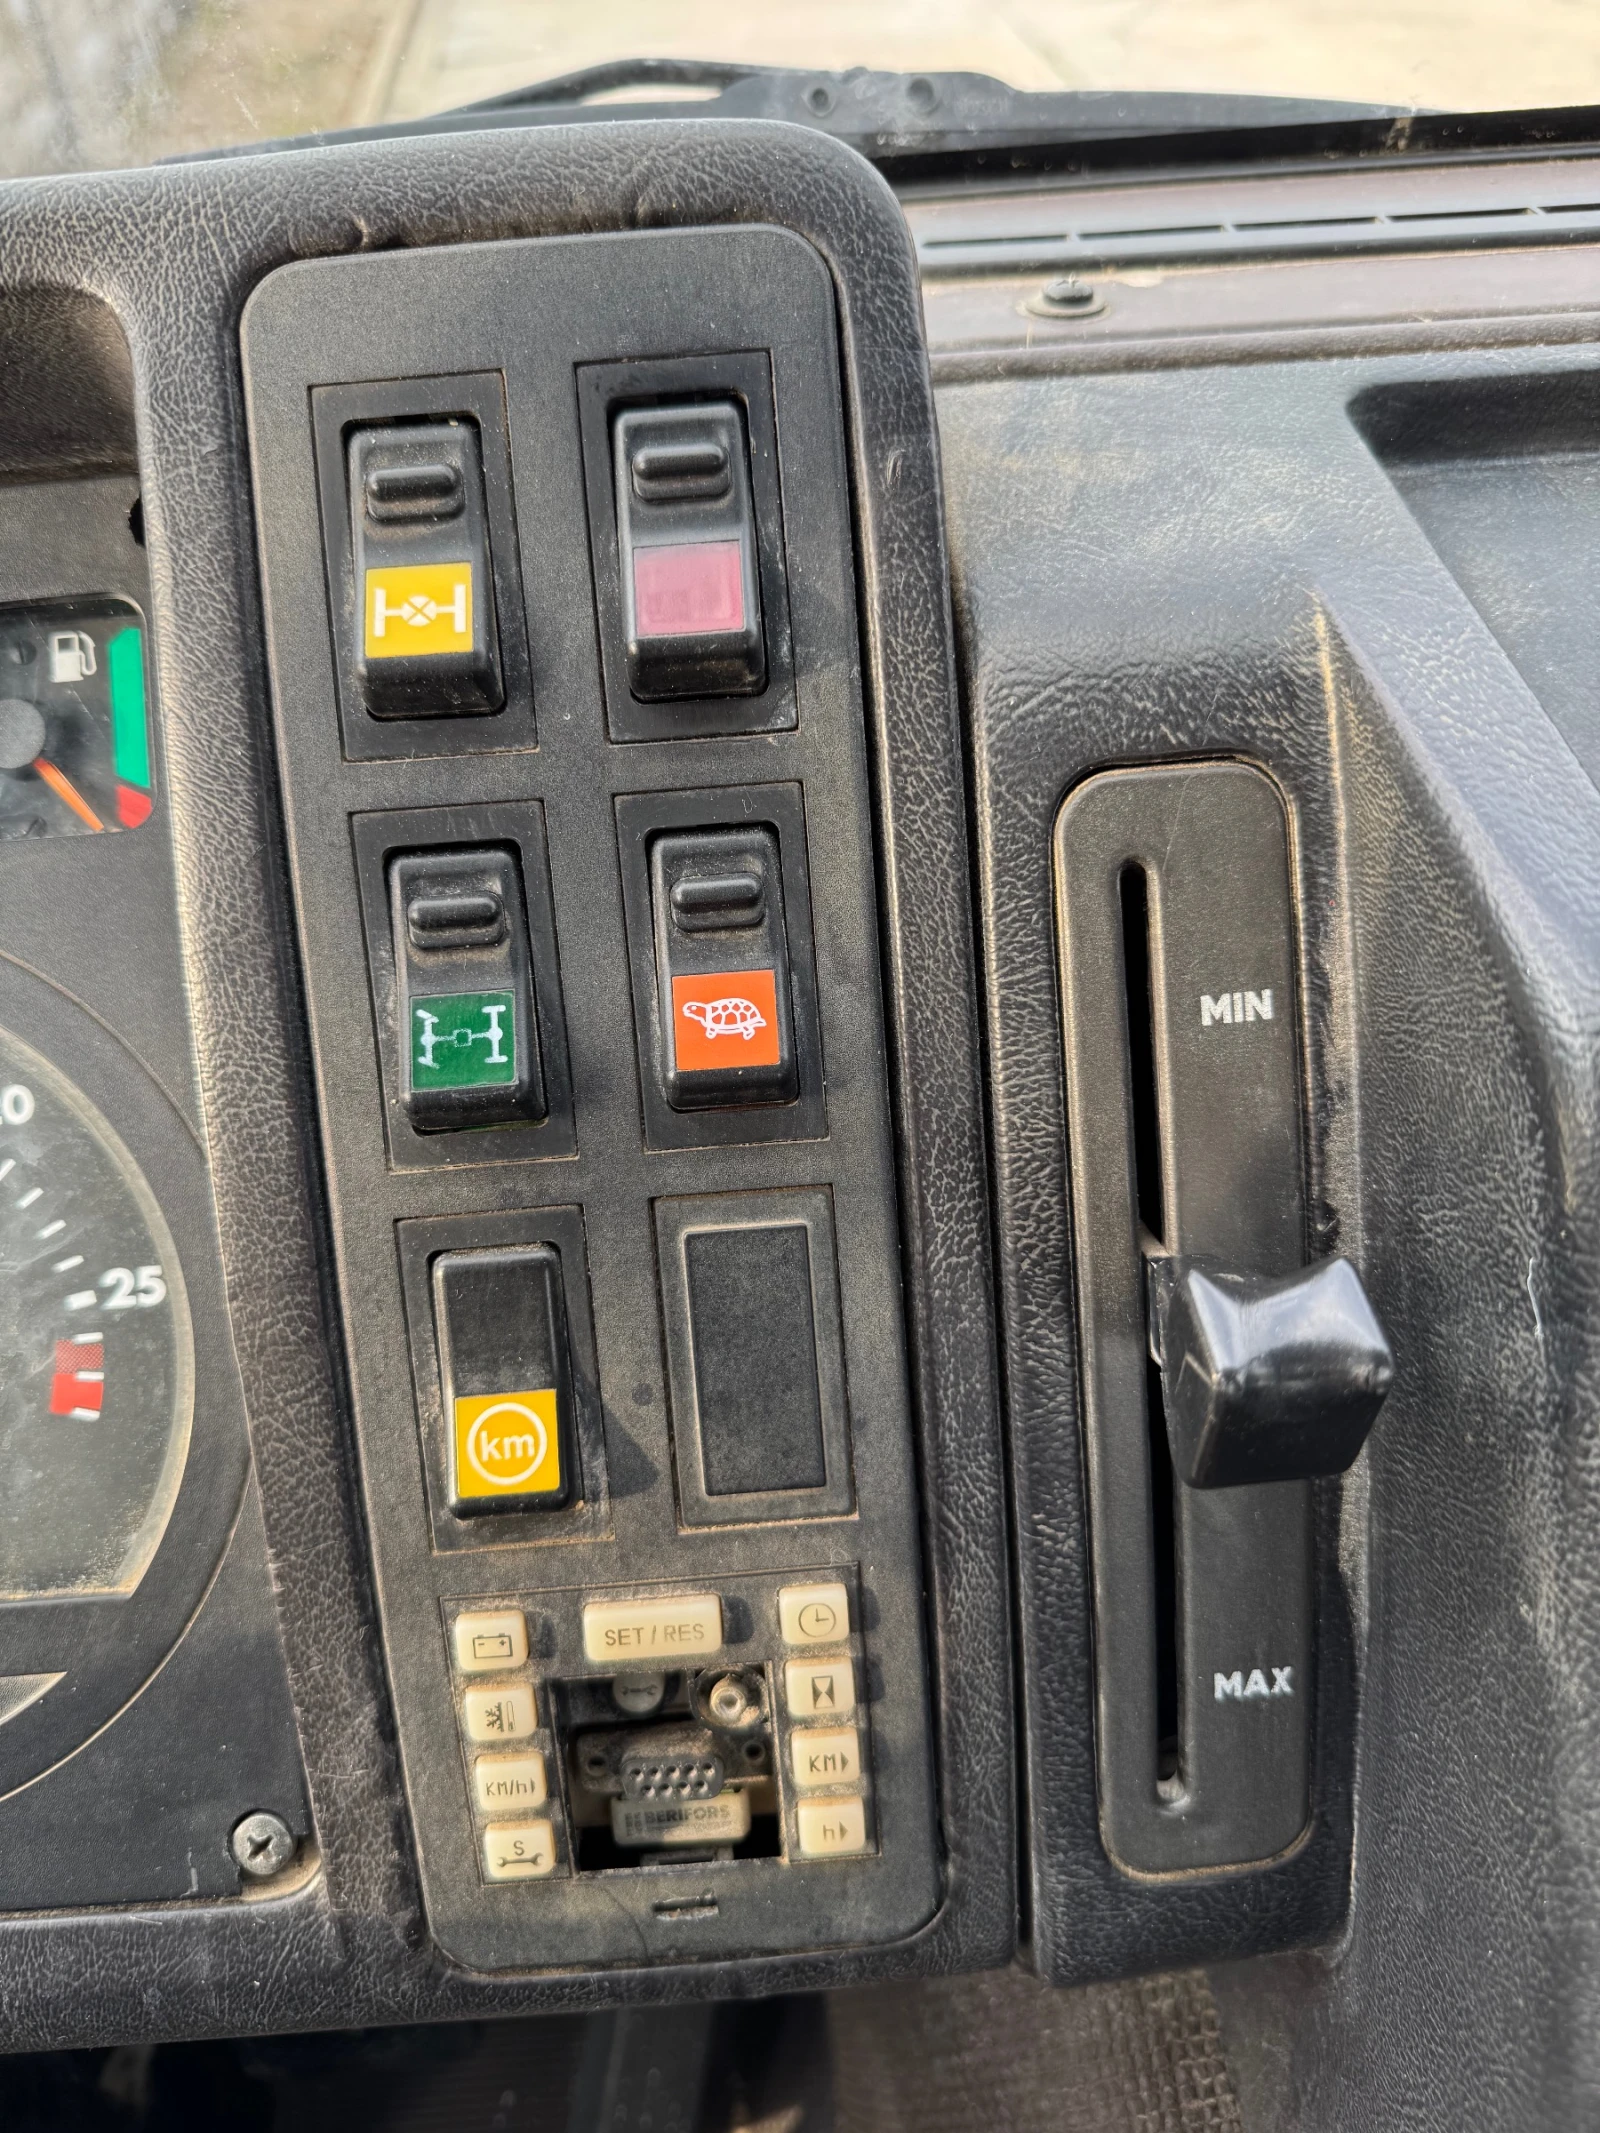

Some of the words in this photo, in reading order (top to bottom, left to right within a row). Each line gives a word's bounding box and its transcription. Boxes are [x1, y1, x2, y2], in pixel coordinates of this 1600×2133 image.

[1200, 988, 1274, 1026] MIN
[0, 1083, 35, 1126] 0
[98, 1264, 167, 1310] 25
[480, 1430, 535, 1462] km
[1213, 1665, 1294, 1702] MAX
[808, 1753, 837, 1773] KM
[513, 1840, 525, 1856] S
